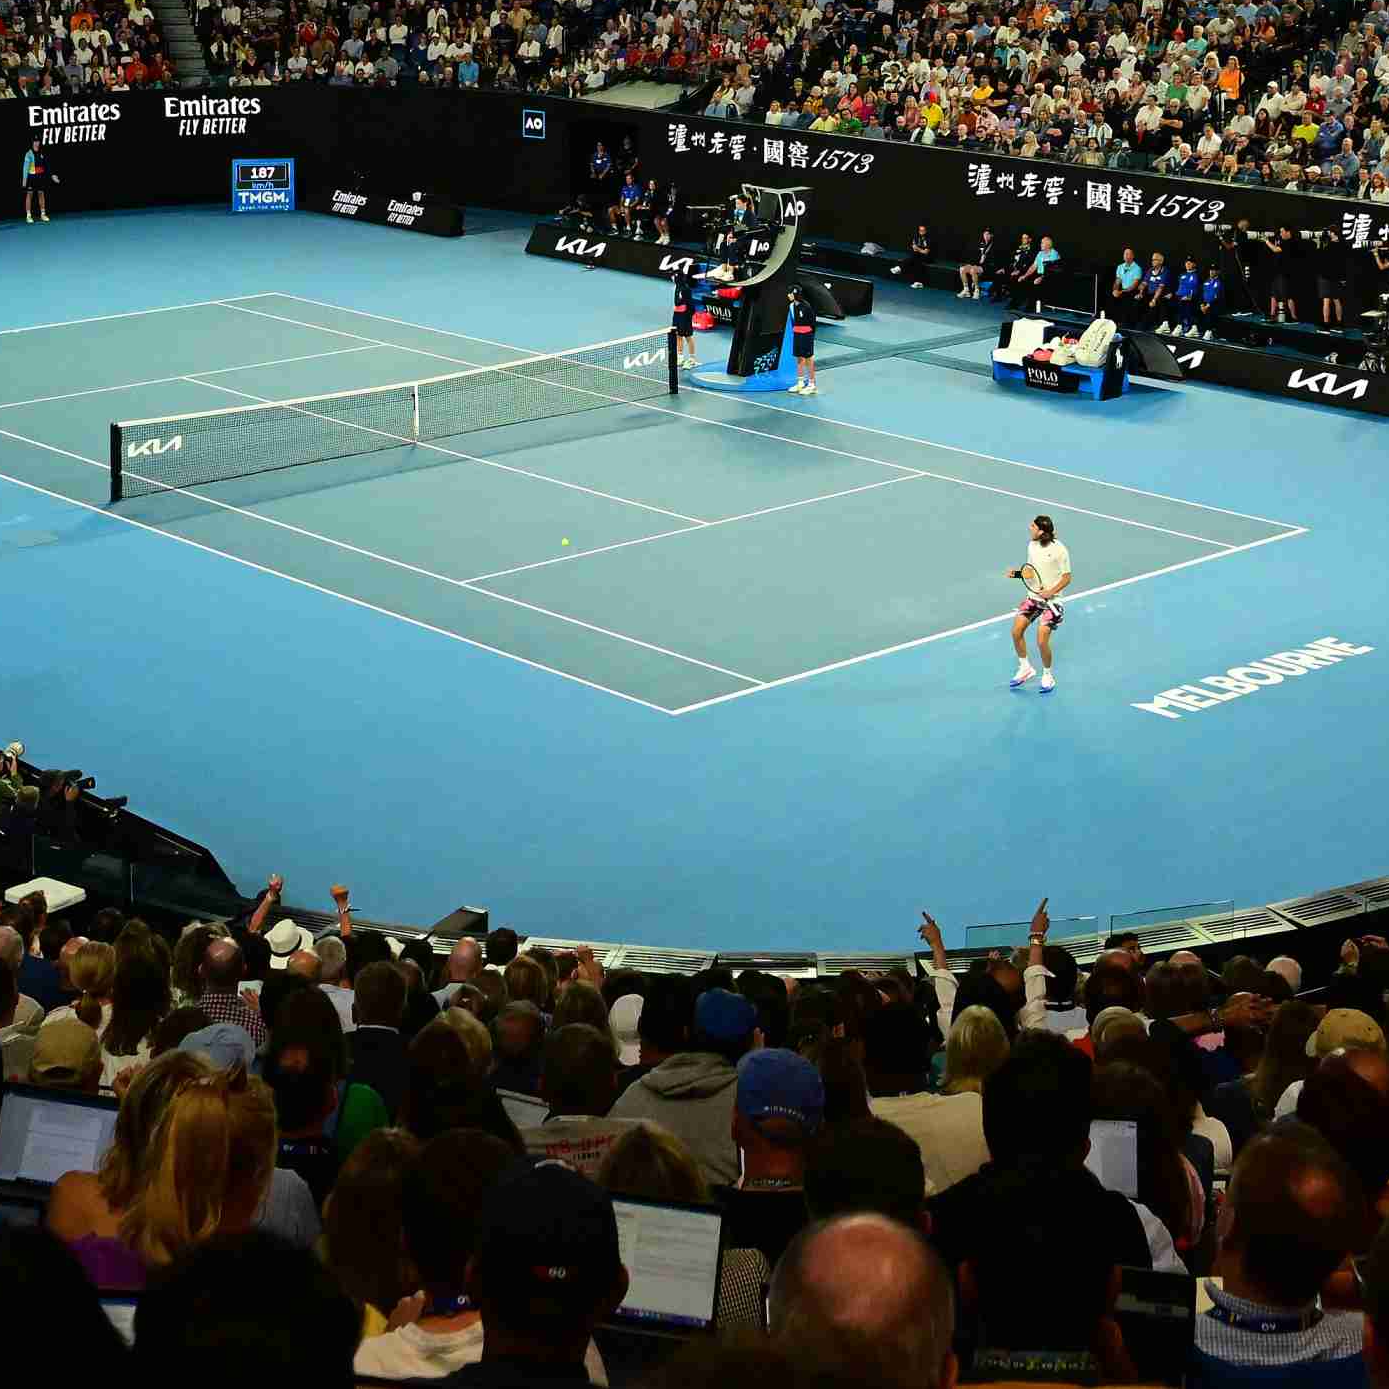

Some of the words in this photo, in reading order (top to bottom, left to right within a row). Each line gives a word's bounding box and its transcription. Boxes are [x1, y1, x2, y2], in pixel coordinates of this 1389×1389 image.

[28, 102, 121, 127] Emirates
[164, 95, 261, 118] Emirates
[179, 118, 198, 136] FLY
[202, 117, 247, 135] BETTER
[526, 116, 544, 131] AO
[42, 127, 59, 145] FLY
[64, 124, 107, 143] BETTER
[250, 167, 274, 179] 187
[331, 190, 367, 206] Emirates
[387, 199, 424, 216] Emirates
[555, 236, 606, 257] KIA
[623, 349, 667, 370] KIA
[1027, 367, 1058, 382] POLO
[1288, 369, 1368, 399] KIA
[128, 435, 182, 458] KIA
[1130, 637, 1374, 718] MELBOURNE
